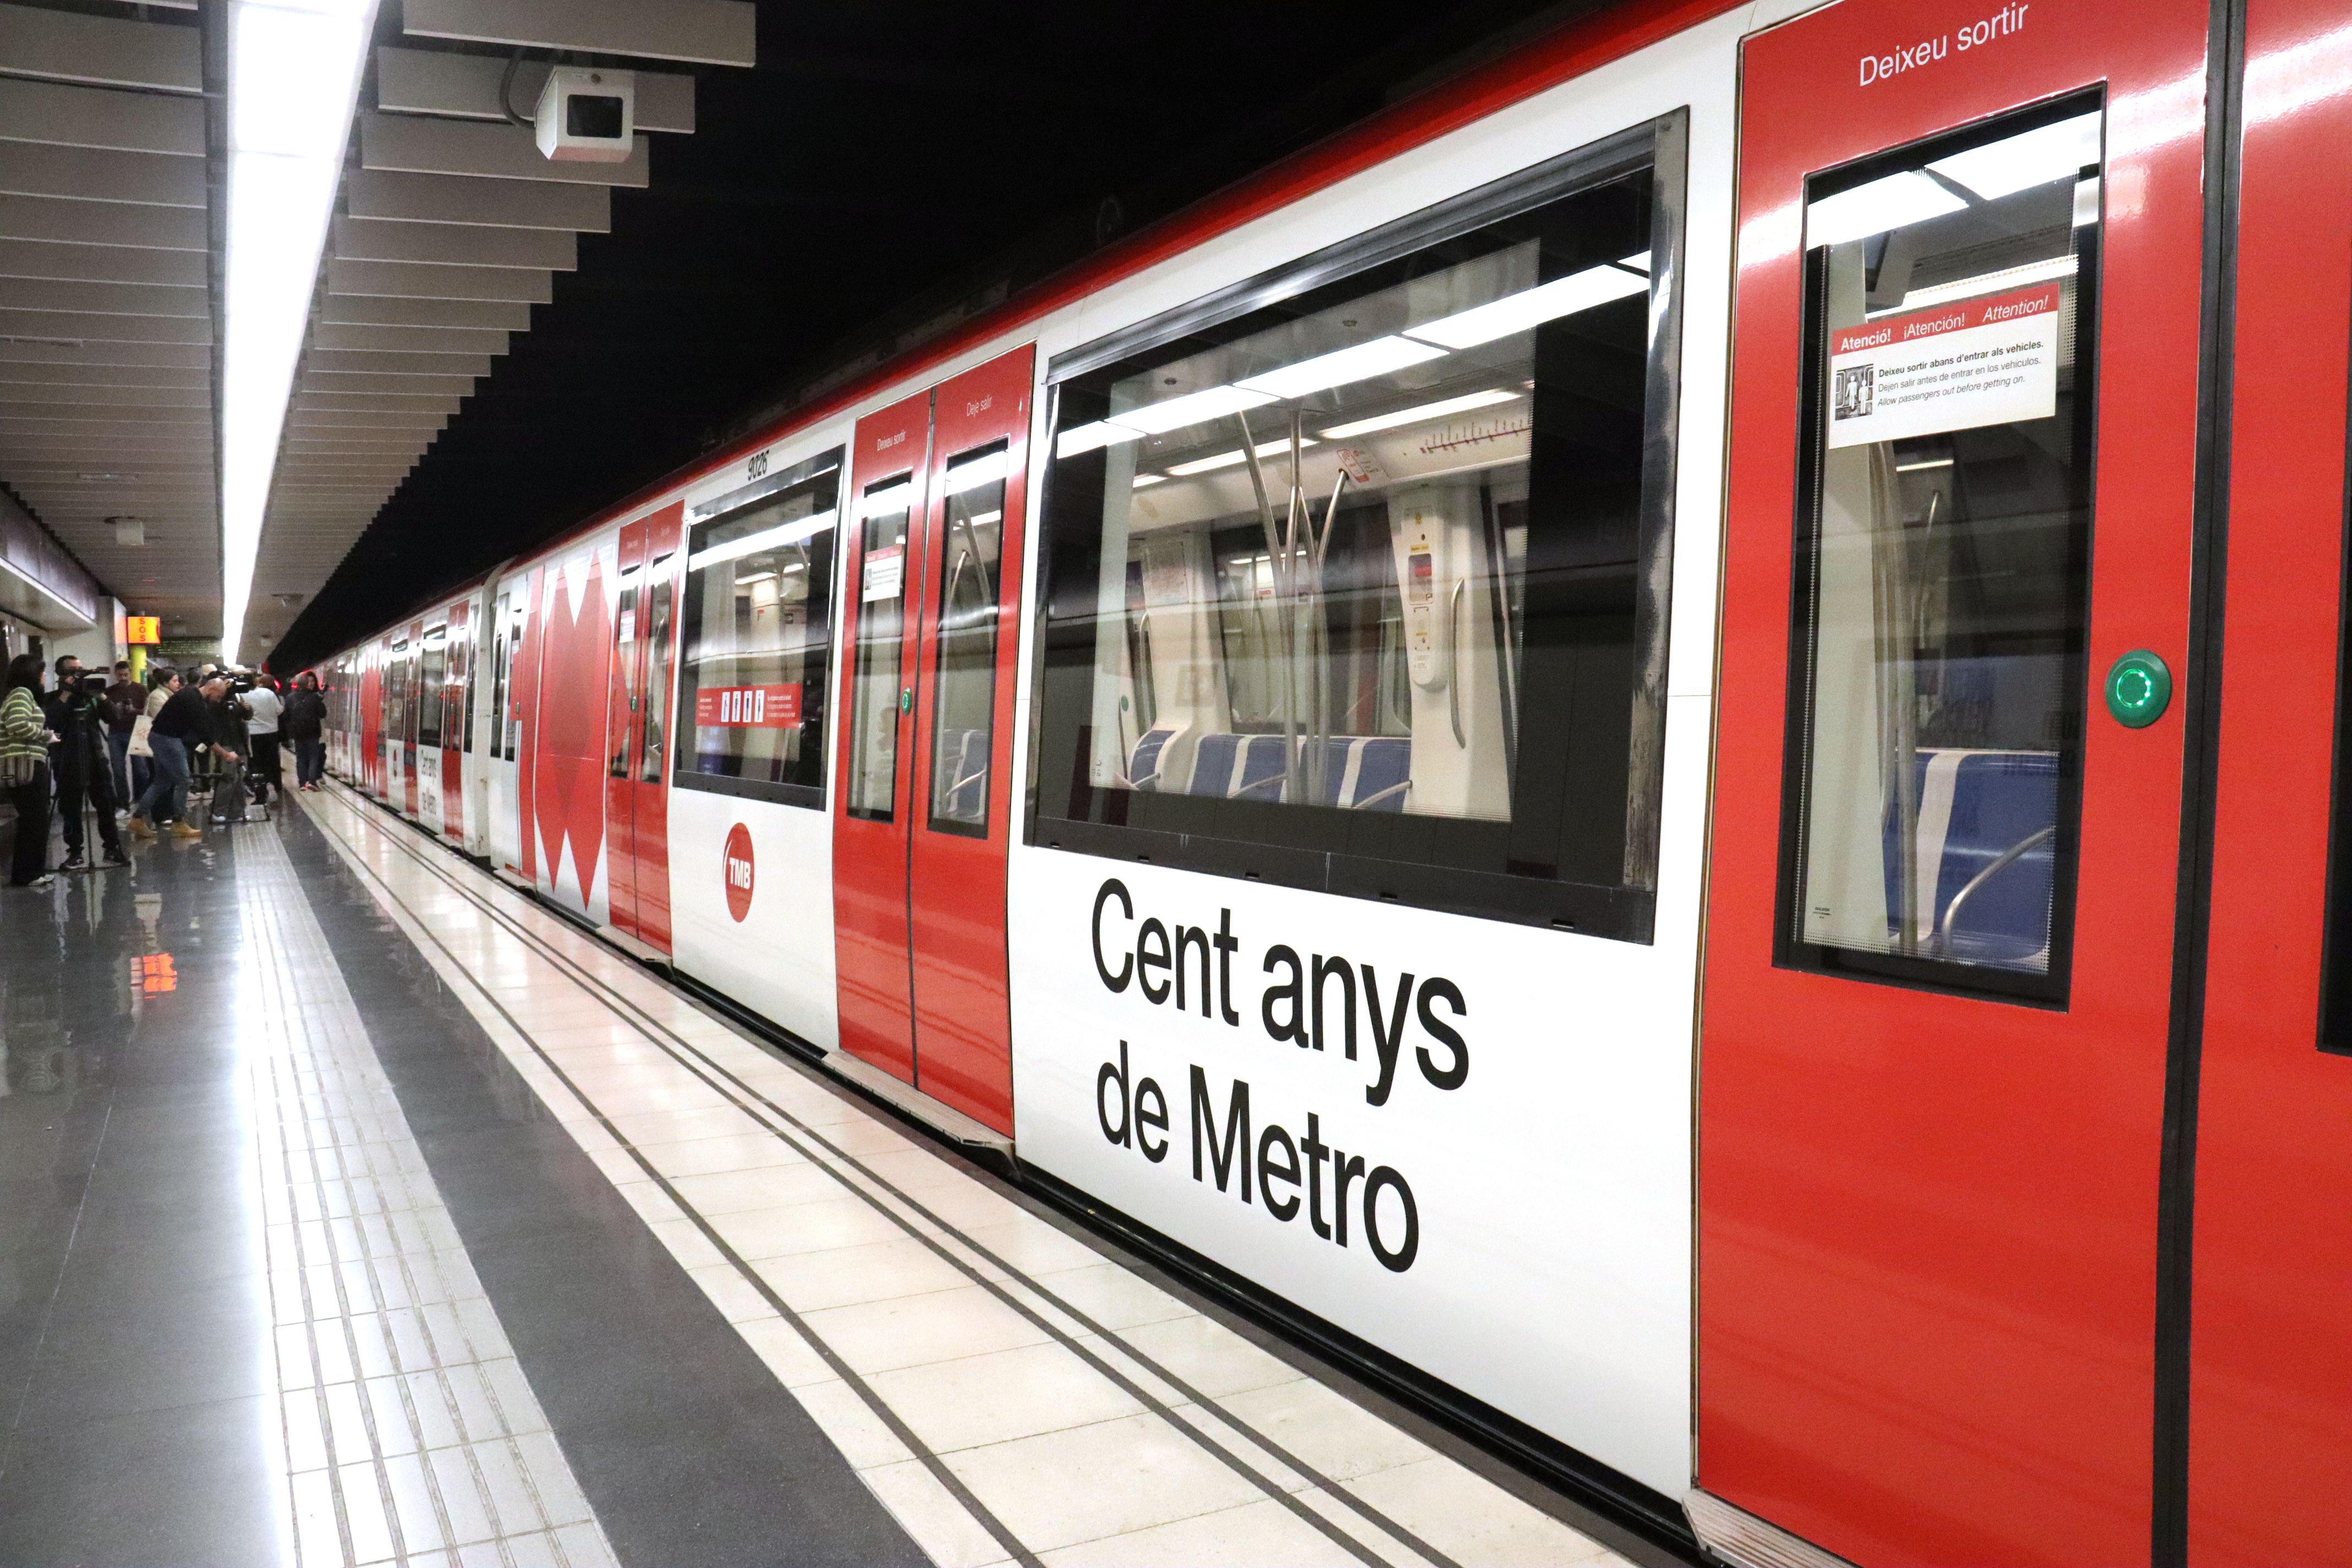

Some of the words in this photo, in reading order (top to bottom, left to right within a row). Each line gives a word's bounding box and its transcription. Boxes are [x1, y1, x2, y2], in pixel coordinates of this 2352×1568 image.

[1860, 35, 1947, 86] Deixeu
[1957, 1, 2029, 51] sortir
[1841, 328, 1891, 351] Atenció!
[1904, 312, 1965, 340] ¡Atención!
[1982, 295, 2049, 323] Attention!
[1879, 367, 1904, 378] Deixeu
[1907, 361, 1928, 372] sortir
[1930, 357, 1954, 368] abans
[1991, 347, 2003, 357] als
[2006, 341, 2044, 354] vehicles.
[1877, 397, 1897, 407] Allow
[1898, 389, 1940, 405] passengers
[1942, 386, 1954, 396] out
[1956, 382, 1981, 393] before
[1983, 378, 2011, 391] getting
[2013, 375, 2026, 384] on.
[1878, 382, 1898, 393] Dejen
[1901, 378, 1915, 388] salir
[1917, 375, 1937, 386] antes
[1939, 372, 1948, 382] de
[1951, 368, 1974, 379] entrar
[1975, 367, 1985, 375] en
[1988, 364, 1999, 373] los
[748, 449, 769, 481] 9026
[729, 857, 751, 890] TMB
[1092, 878, 1239, 1027] Cent
[1262, 943, 1469, 1107] anys
[1097, 1039, 1169, 1164] de
[1189, 1063, 1419, 1273] Metro
